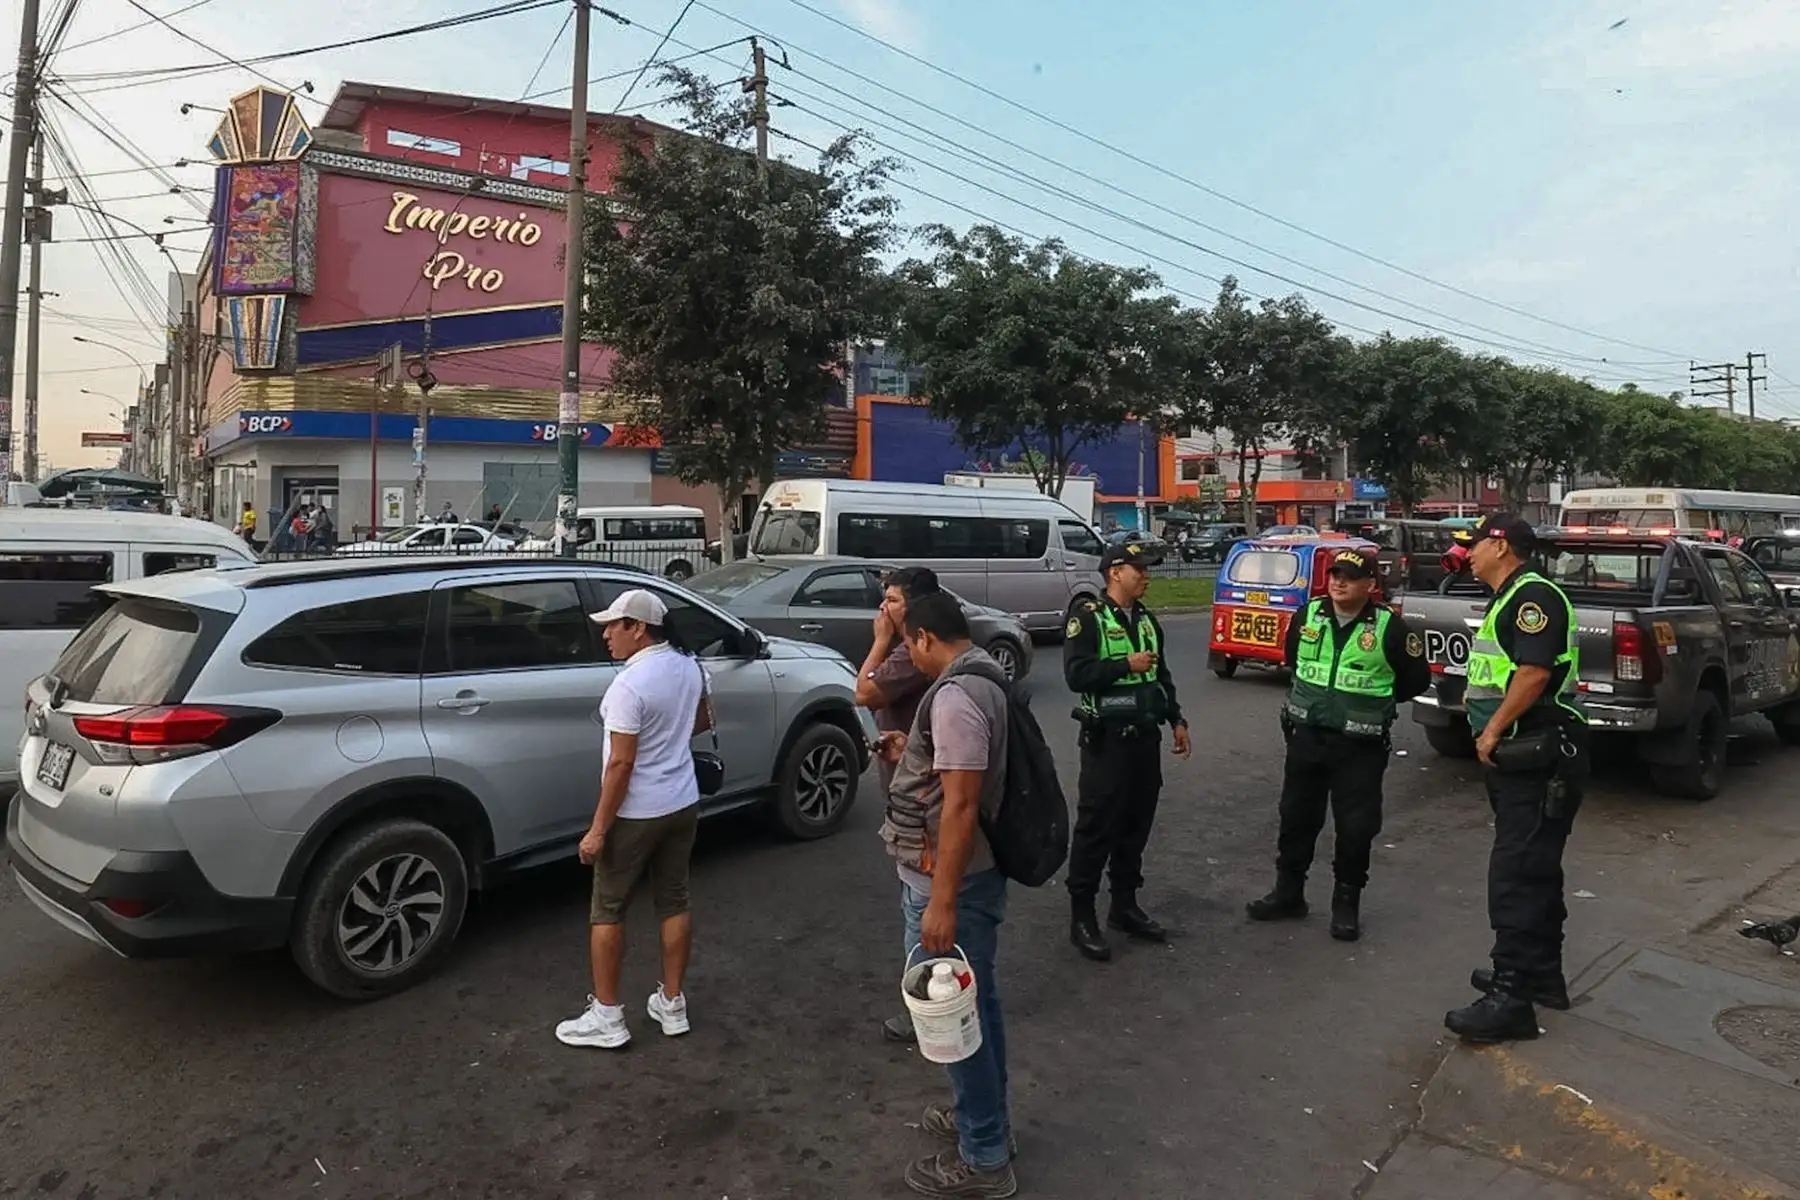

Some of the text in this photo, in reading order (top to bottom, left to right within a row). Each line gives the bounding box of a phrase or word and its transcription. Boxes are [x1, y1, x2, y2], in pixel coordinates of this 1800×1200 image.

[383, 191, 542, 246] Imperio
[423, 250, 504, 292] Pro
[247, 415, 283, 432] BCP
[1334, 550, 1365, 568] POLICIA
[1424, 630, 1475, 667] PO
